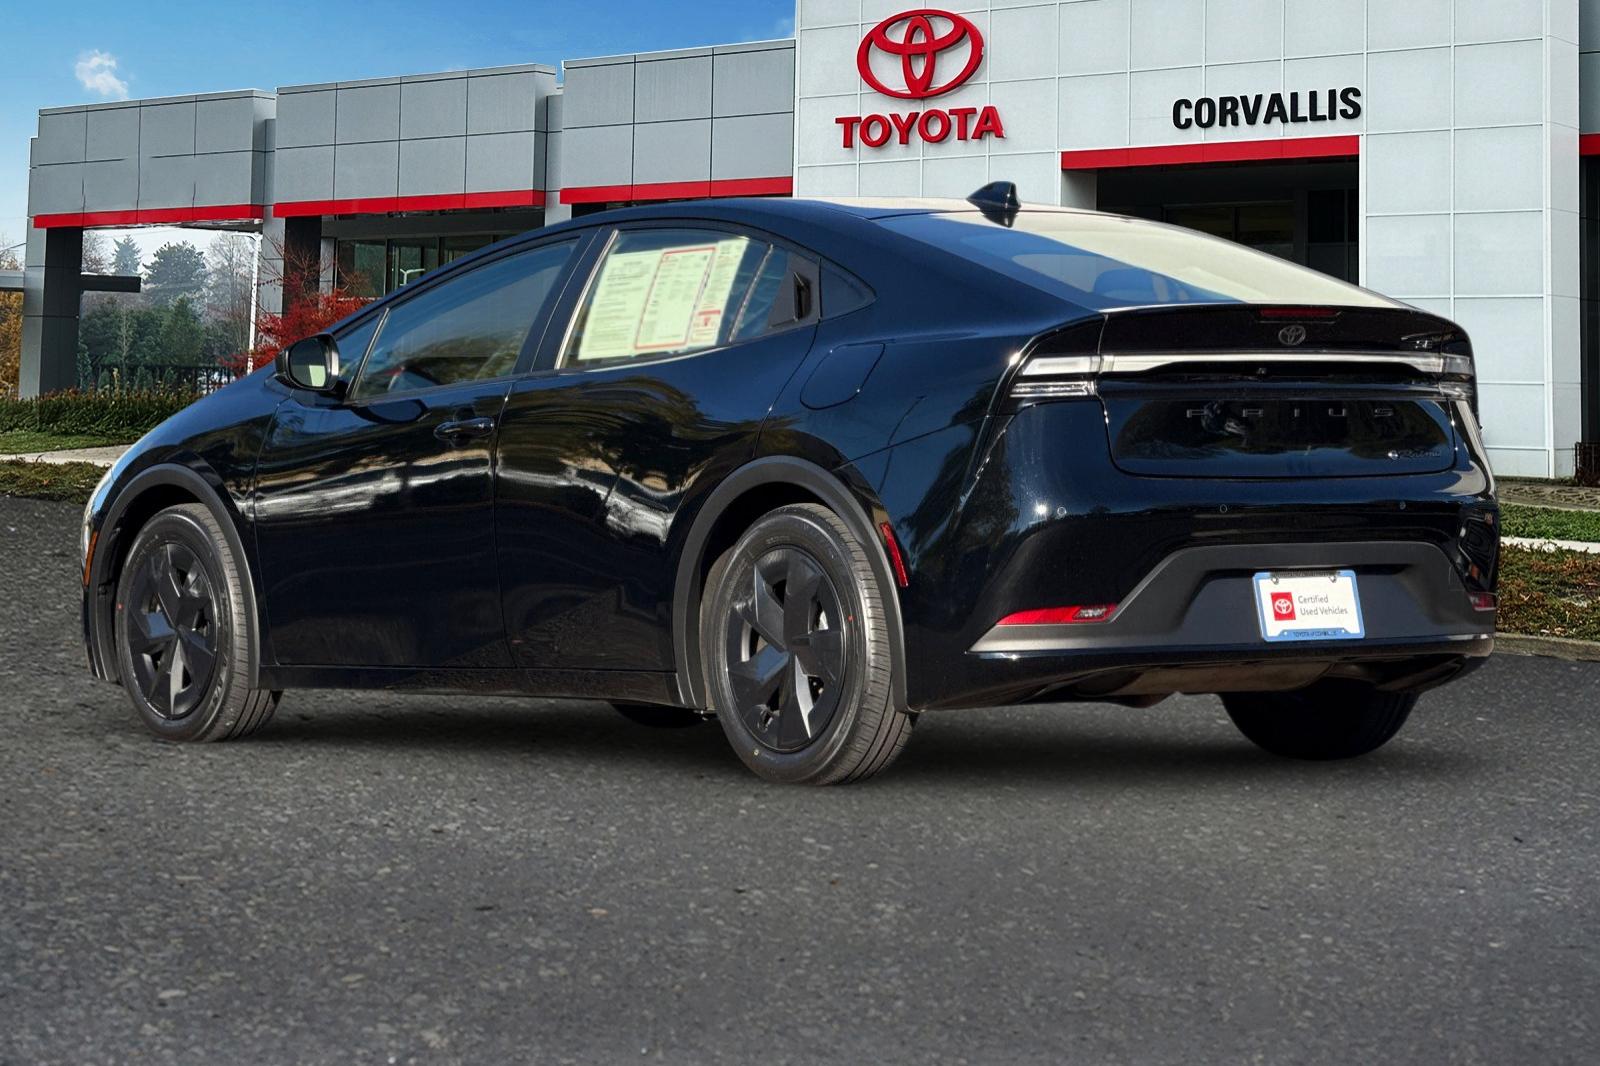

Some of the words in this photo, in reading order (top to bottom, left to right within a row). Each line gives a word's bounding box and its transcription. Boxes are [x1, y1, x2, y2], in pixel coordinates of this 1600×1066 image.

[1172, 87, 1362, 130] CORVALLIS
[835, 106, 1004, 148] TOYOTA
[1298, 594, 1328, 604] Certified
[1300, 607, 1318, 615] Used
[1320, 606, 1348, 615] Vehicles
